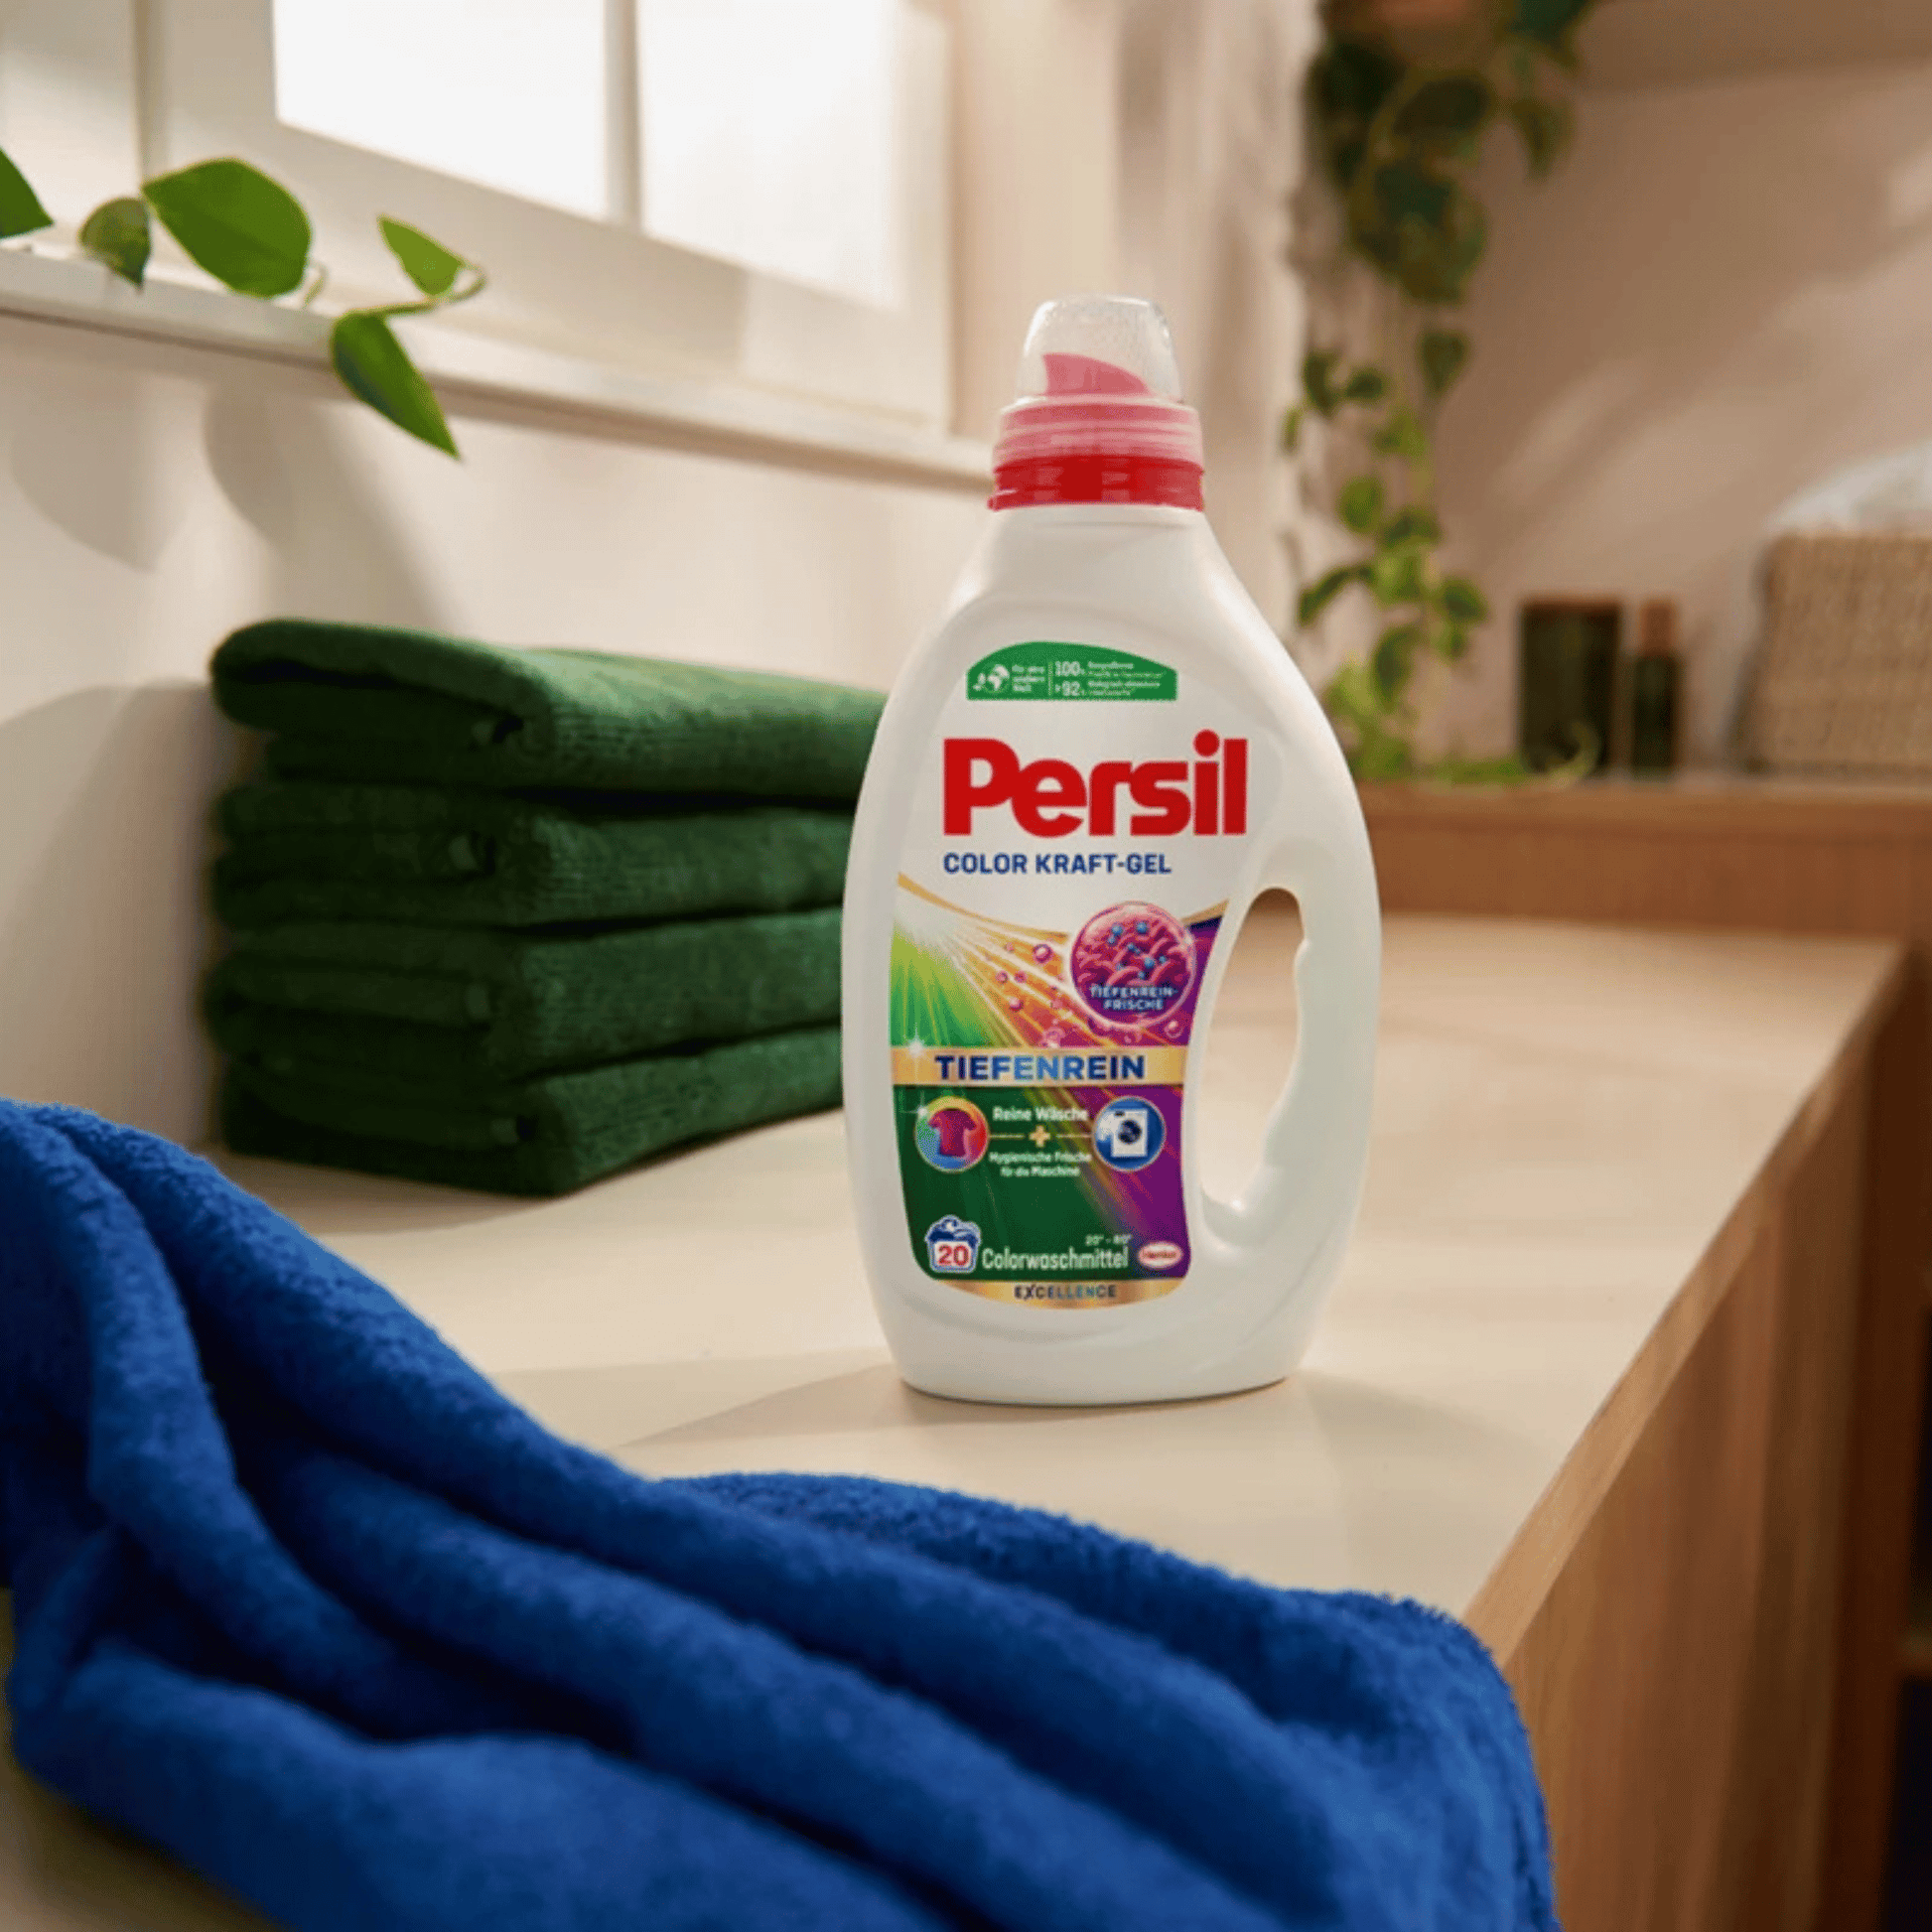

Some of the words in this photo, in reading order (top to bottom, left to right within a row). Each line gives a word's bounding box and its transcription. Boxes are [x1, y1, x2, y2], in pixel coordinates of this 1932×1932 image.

[943, 729, 1247, 837] Persil
[943, 853, 1028, 874] COLOR
[1035, 853, 1172, 874] KRAFT-GEL
[1103, 999, 1164, 1011] FRISCHE
[935, 1055, 1145, 1080] TIEFENREIN
[993, 1107, 1032, 1121] Reine
[1035, 1106, 1088, 1121] Wäsche
[989, 1152, 1051, 1165] Hygienische
[1054, 1152, 1092, 1163] Frische
[1031, 1166, 1080, 1176] Maschine
[938, 1245, 969, 1267] 20
[982, 1246, 1129, 1270] Colorwaschmittel
[1014, 1284, 1117, 1299] EXCELLENCE
